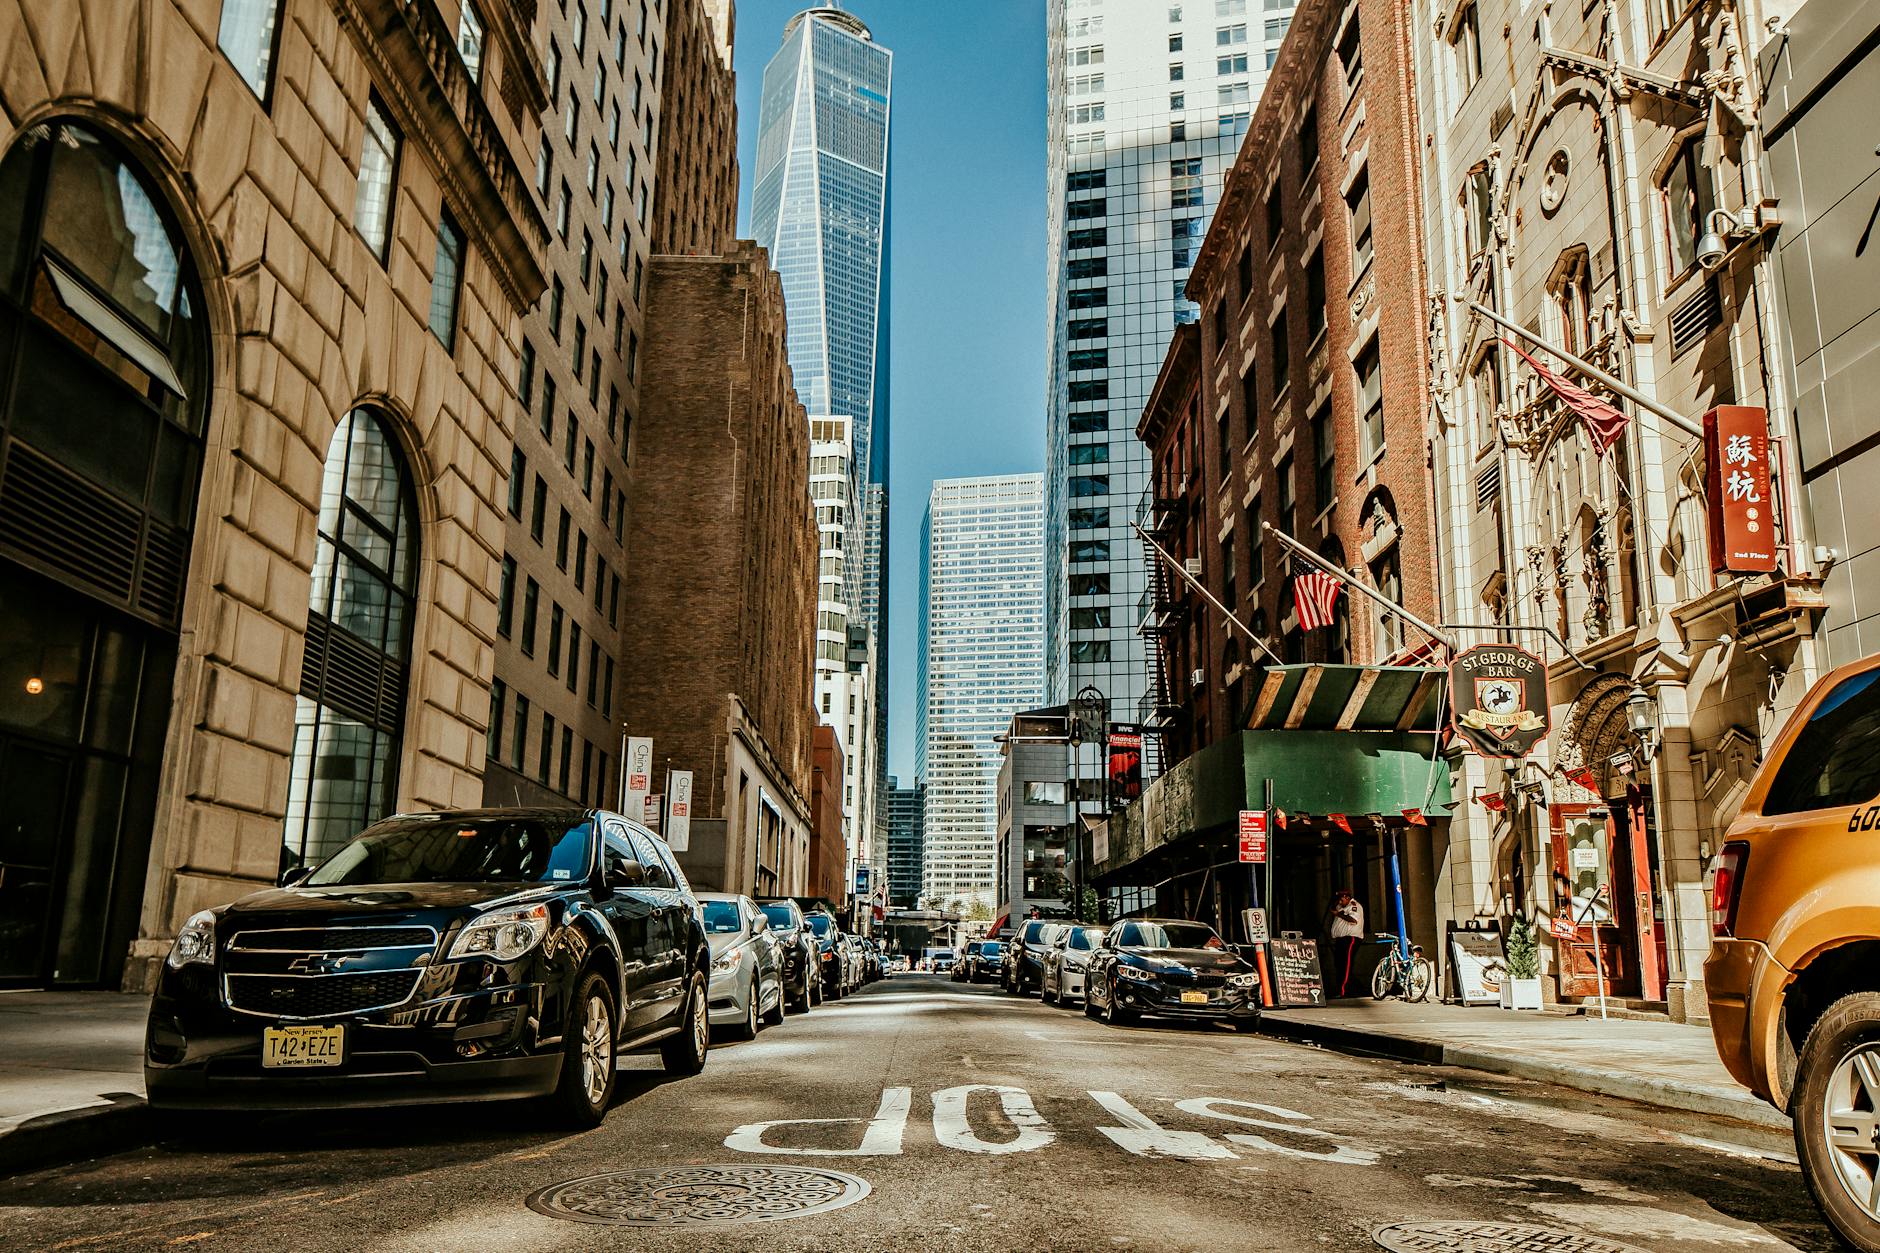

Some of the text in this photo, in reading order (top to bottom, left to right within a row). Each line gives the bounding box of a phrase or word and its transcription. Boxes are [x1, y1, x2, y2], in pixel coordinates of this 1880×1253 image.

[1488, 666, 1516, 678] BAR
[1475, 711, 1529, 724] RESTAURANT
[1109, 734, 1141, 743] financial
[636, 744, 649, 773] China
[678, 777, 689, 802] China
[284, 1027, 324, 1037] New Jersey
[269, 1035, 338, 1058] T42 EZE
[724, 1085, 1381, 1166] STOP
